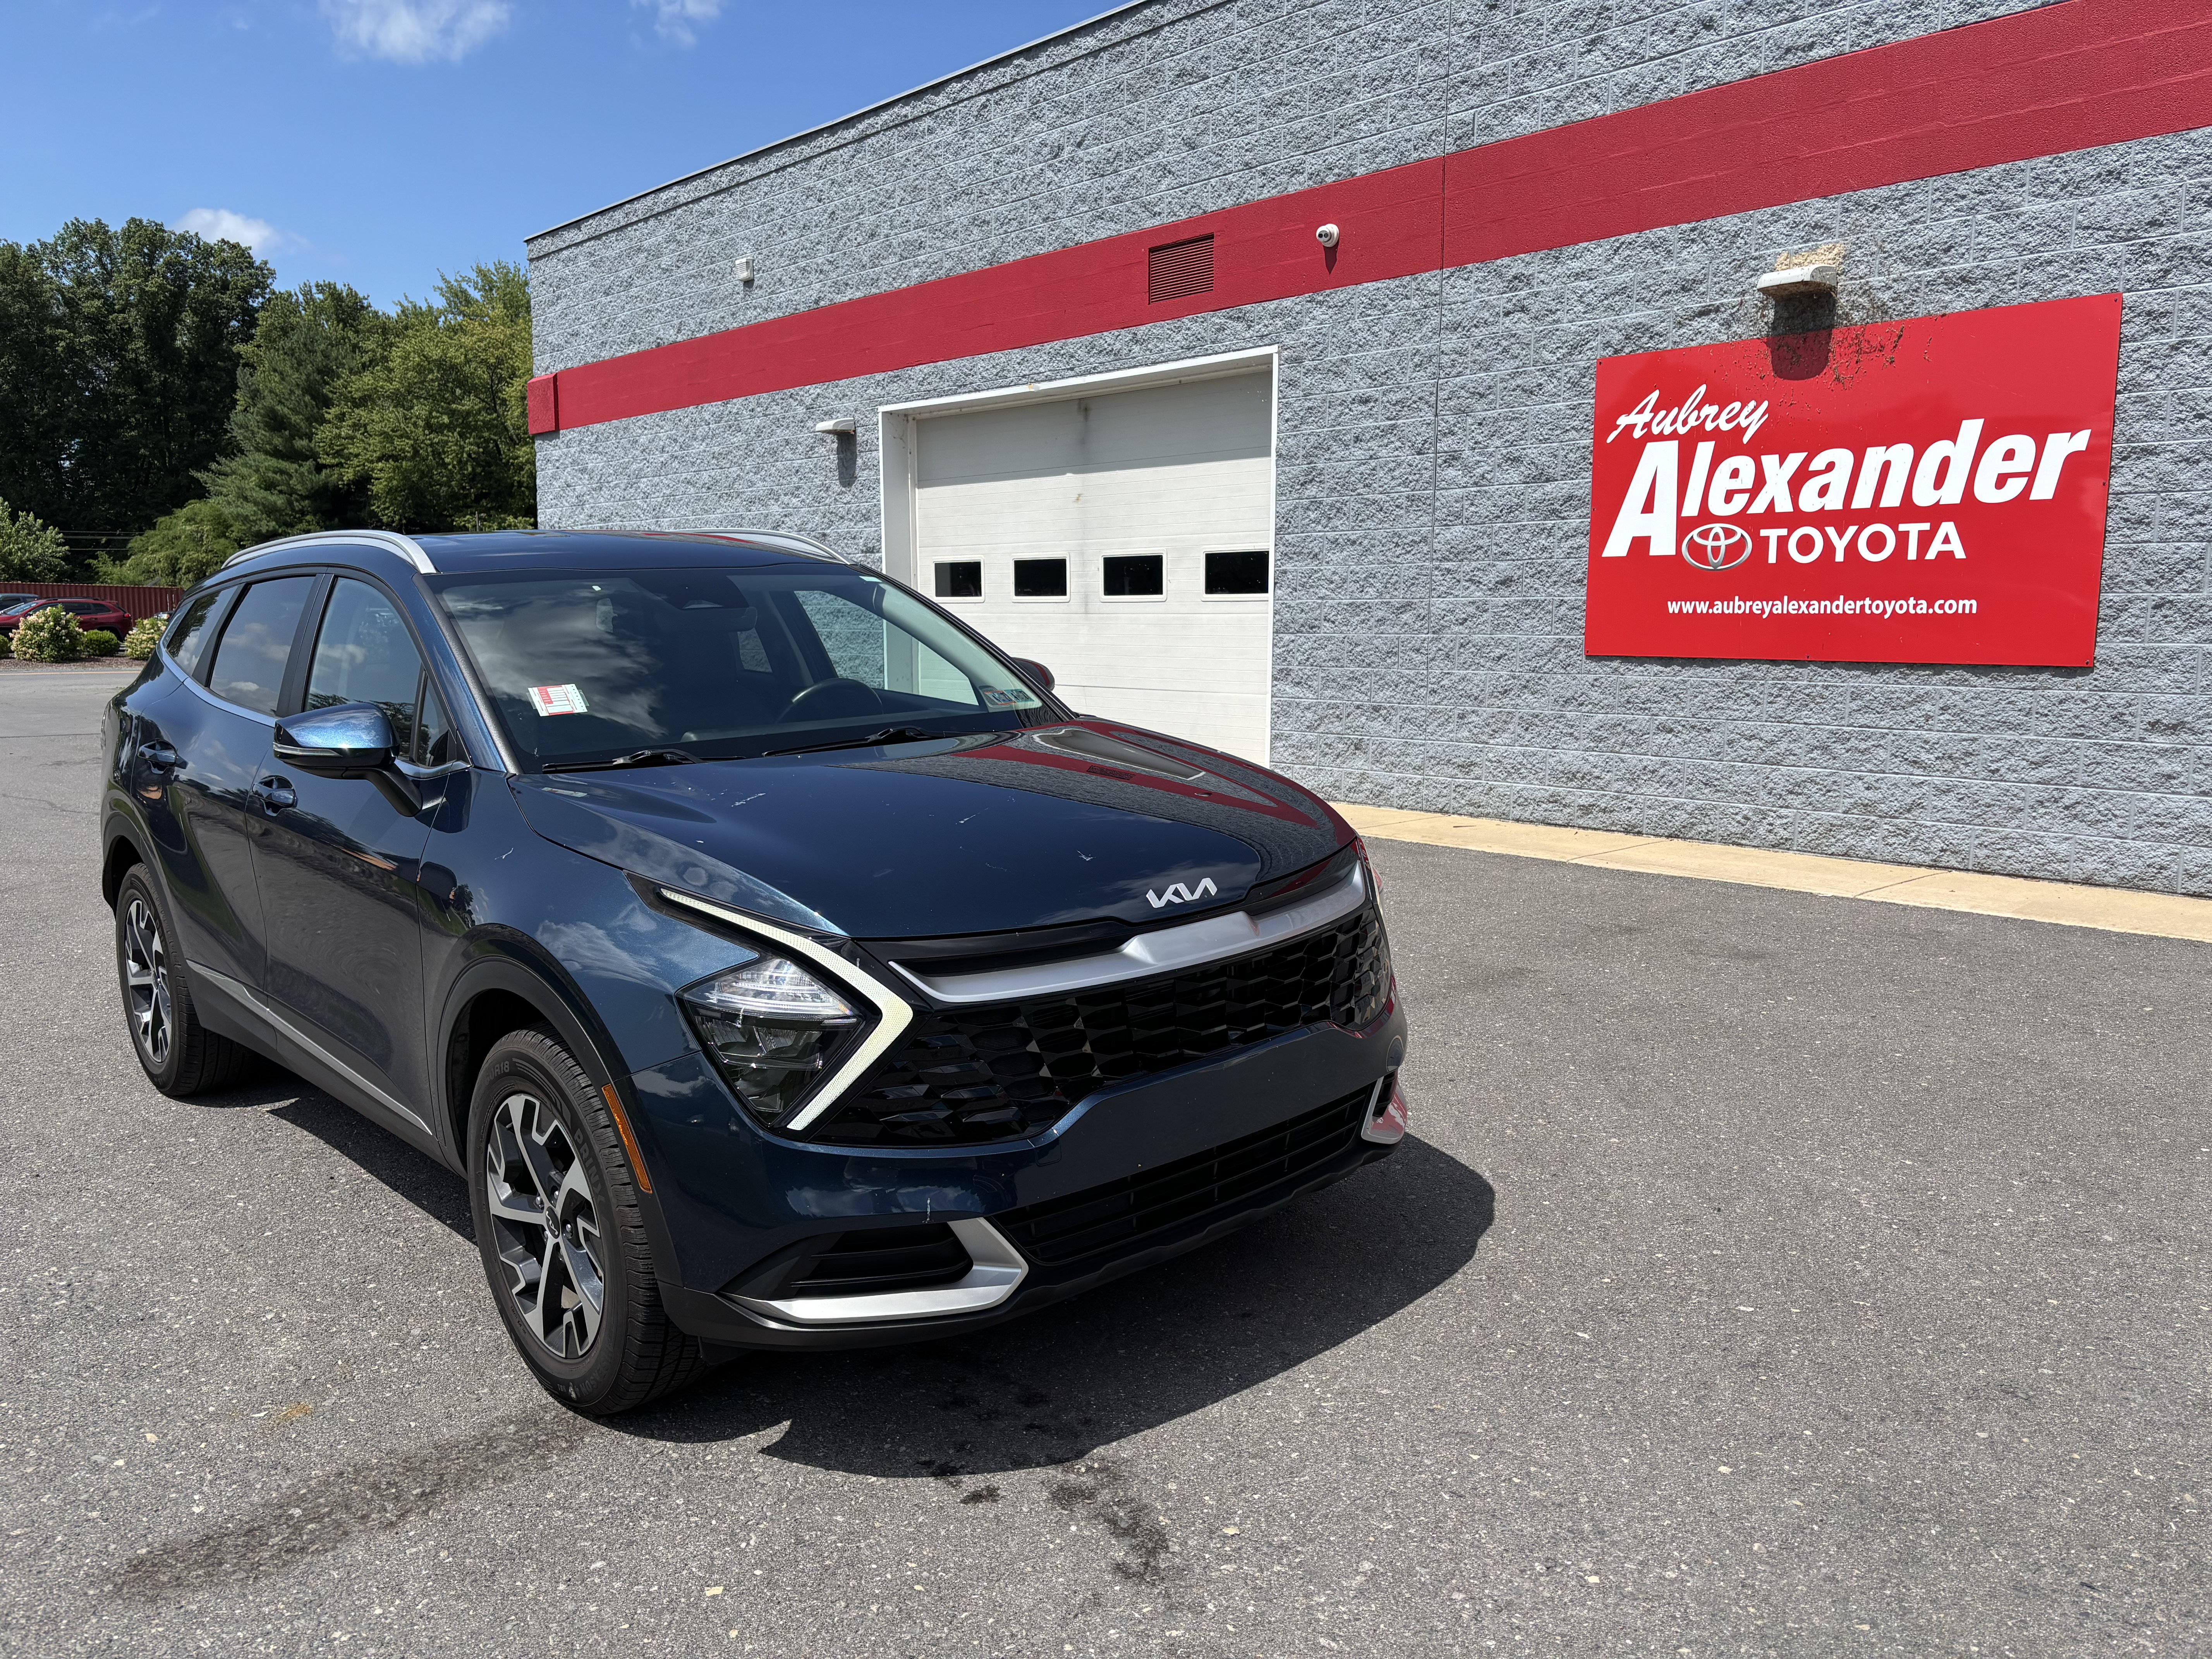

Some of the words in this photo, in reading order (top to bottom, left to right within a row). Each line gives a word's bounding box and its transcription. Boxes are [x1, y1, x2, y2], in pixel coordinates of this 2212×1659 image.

[1606, 384, 1769, 445] Aubrey
[1602, 418, 2092, 558] Alexander
[1760, 521, 1966, 564] TOYOTA
[1667, 595, 1977, 619] www.aubreyalexandertoyota.com
[1146, 878, 1217, 908] KIA
[574, 1128, 605, 1206] PRINX
